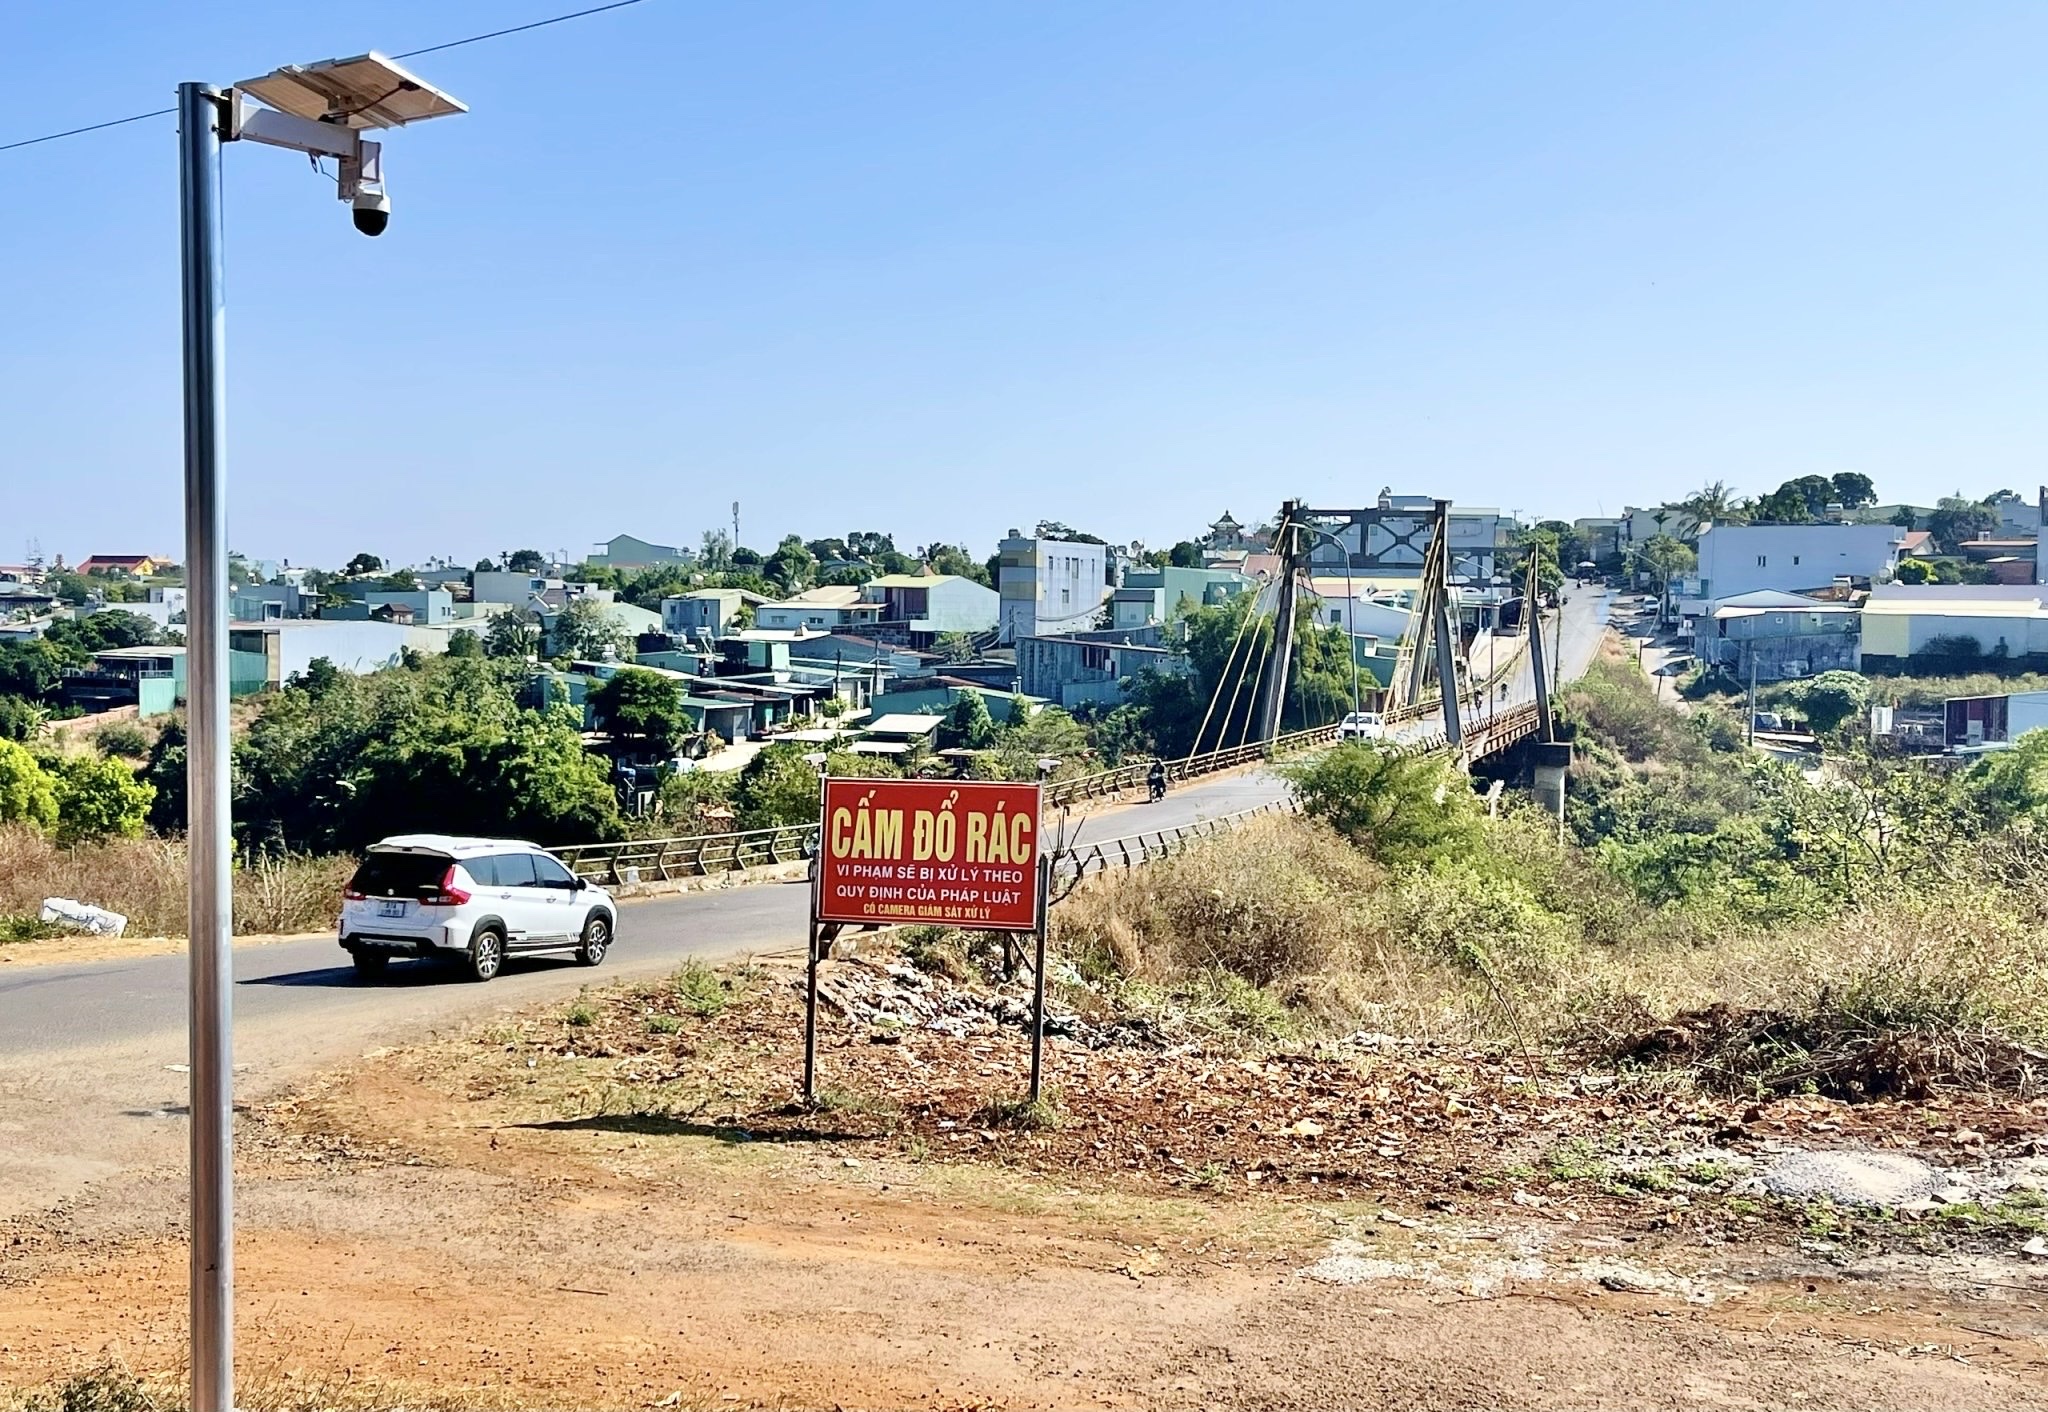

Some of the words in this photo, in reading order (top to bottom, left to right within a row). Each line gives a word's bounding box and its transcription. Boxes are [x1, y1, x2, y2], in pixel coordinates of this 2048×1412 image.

[831, 790, 903, 859] CẤM
[912, 789, 959, 862] ĐỔ
[966, 801, 1031, 865] RÁC
[836, 864, 850, 877] VI
[852, 864, 893, 880] PHẠM
[897, 864, 916, 879] SẼ
[919, 867, 934, 883] BỊ
[937, 863, 959, 881] XỬ
[960, 866, 979, 882] LÝ
[982, 869, 1023, 884] THEO
[836, 884, 866, 898] QUY
[869, 886, 903, 901] ĐỊNH
[907, 883, 936, 901] CỦA
[940, 887, 979, 902] PHÁP
[983, 888, 1021, 906] LUẬT
[863, 902, 876, 914] CÓ
[878, 904, 916, 916] CAMERA
[918, 904, 942, 917] GIÁM
[944, 905, 963, 918] SÁT
[979, 906, 991, 919] LÝ
